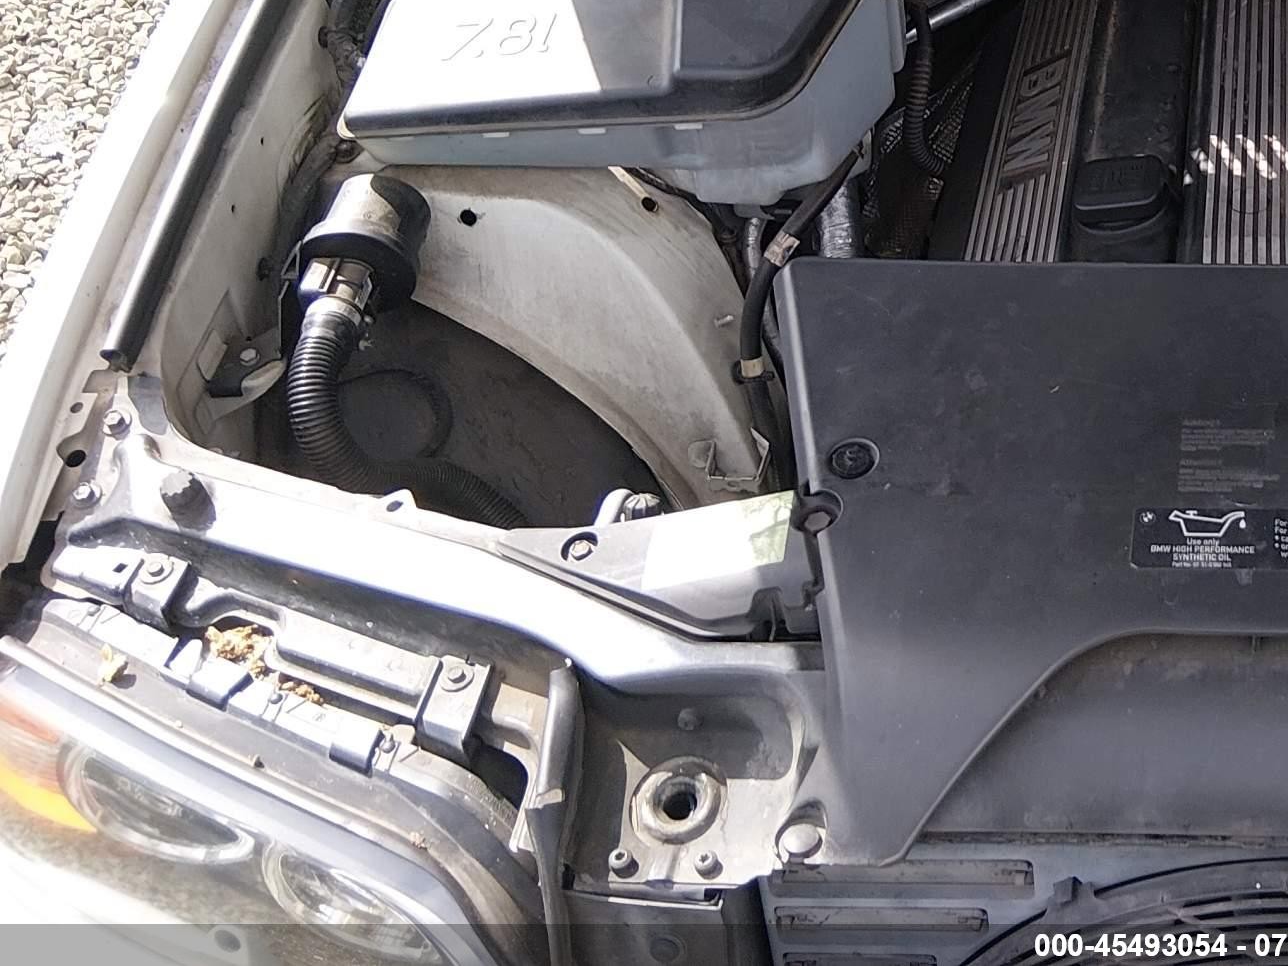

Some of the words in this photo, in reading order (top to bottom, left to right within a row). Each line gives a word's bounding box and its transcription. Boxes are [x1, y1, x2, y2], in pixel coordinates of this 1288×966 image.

[1003, 57, 1068, 171] BMW
[1274, 518, 1288, 526] For
[1186, 538, 1202, 546] Use
[1203, 538, 1220, 547] only
[1150, 545, 1171, 553] BMW
[1172, 545, 1192, 553] HIGH
[1194, 545, 1255, 554] PERFORMANCE
[1173, 553, 1217, 561] SYNTHETIC
